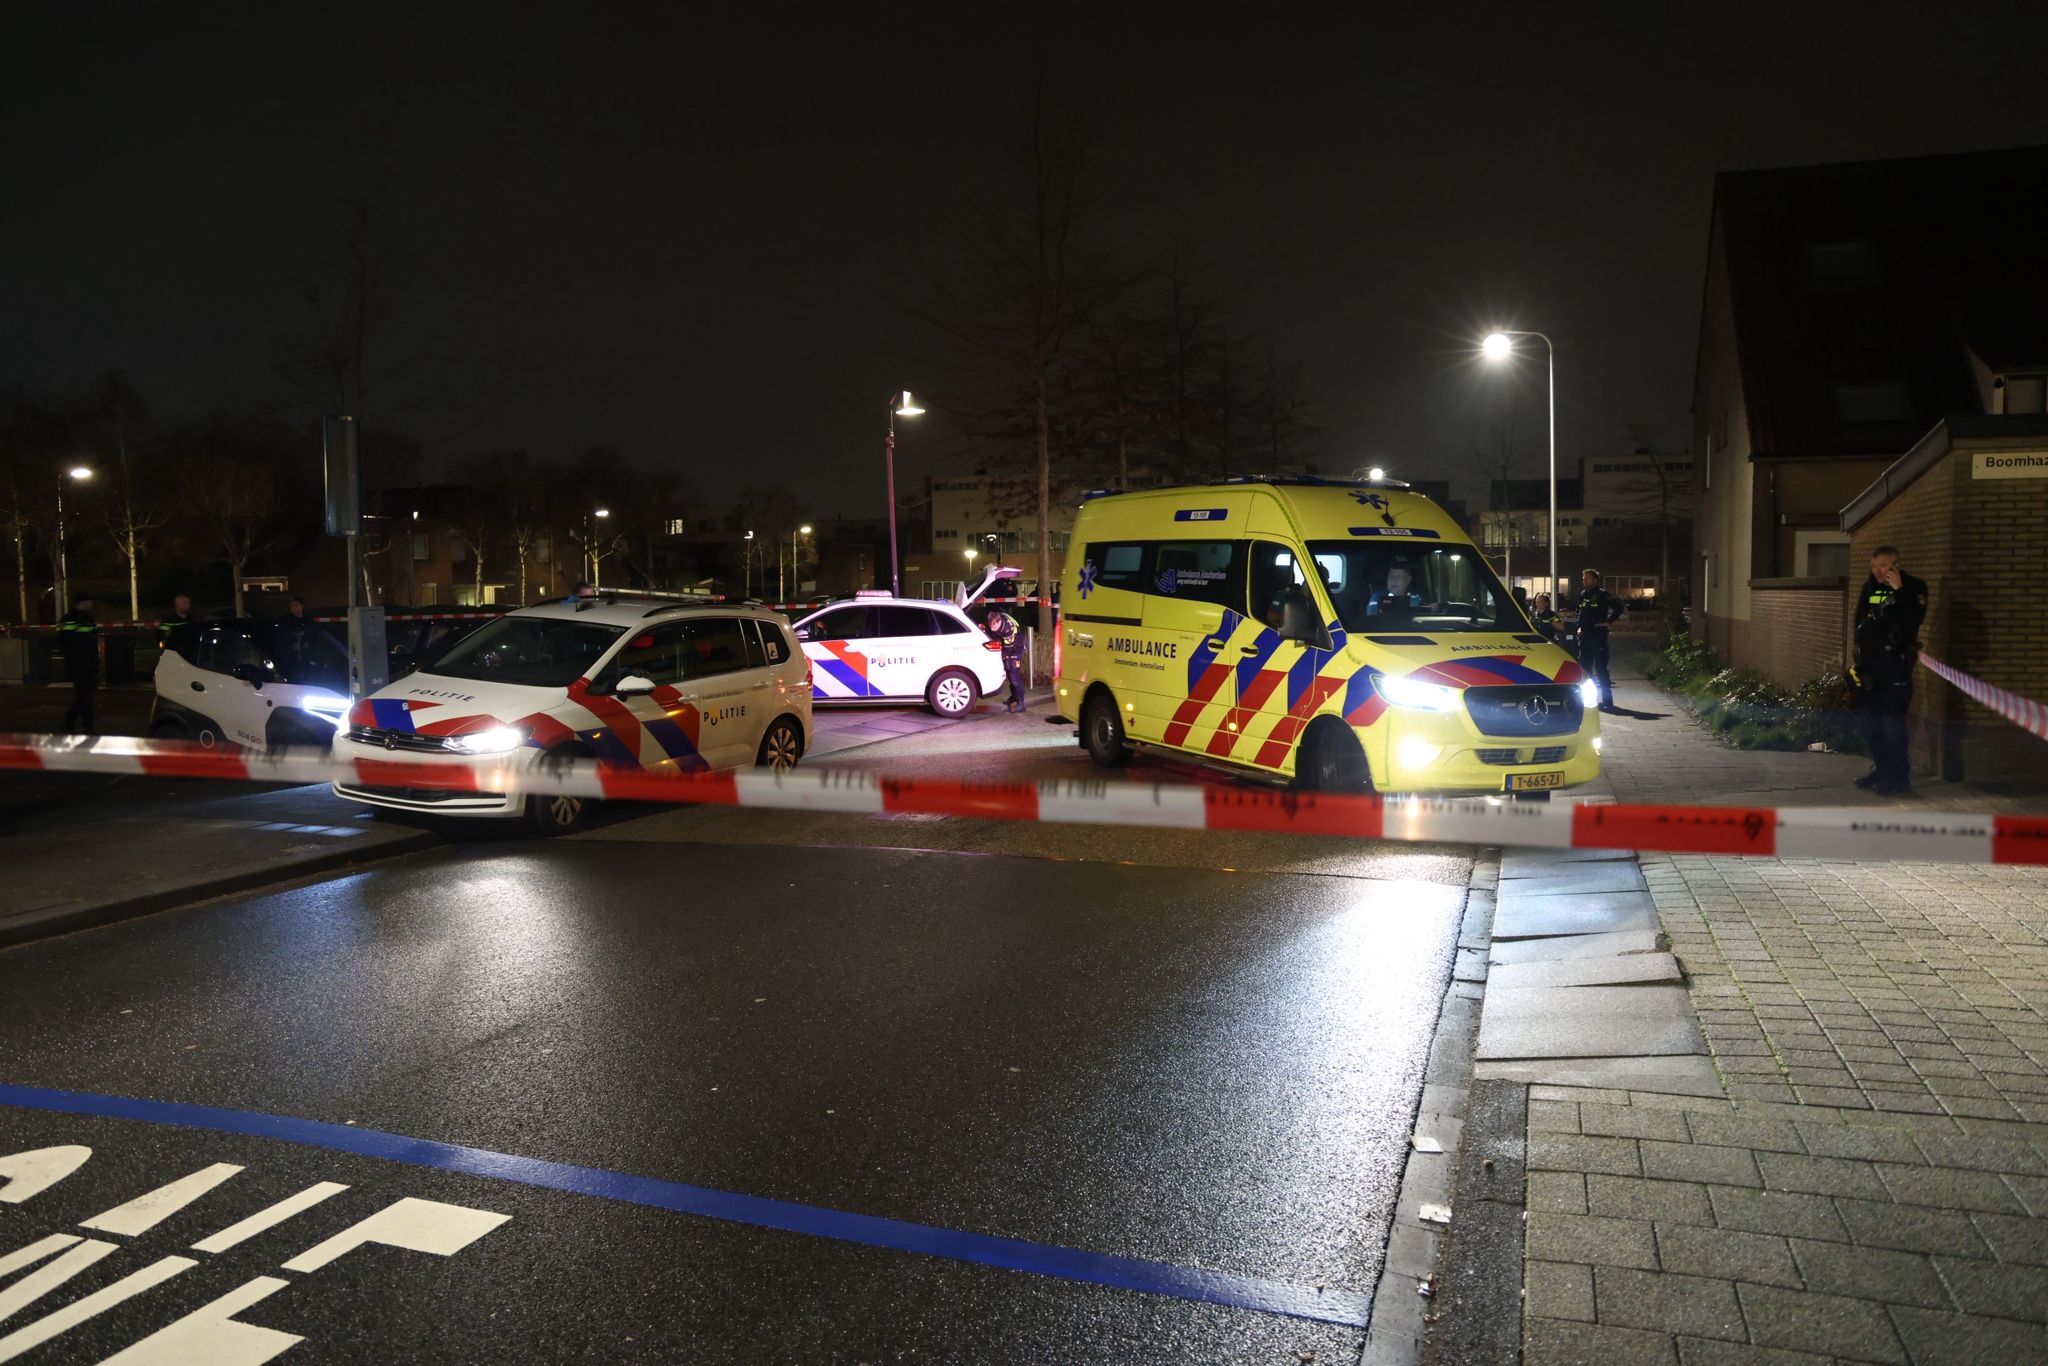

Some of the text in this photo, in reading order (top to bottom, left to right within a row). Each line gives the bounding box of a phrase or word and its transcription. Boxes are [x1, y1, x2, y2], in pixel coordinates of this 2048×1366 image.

[1107, 637, 1177, 659] AMBULANCE
[1451, 644, 1535, 652] AMBULANCE
[871, 656, 917, 668] POLITIE
[408, 688, 476, 702] POLITIE
[704, 705, 746, 726] POLITIE
[1516, 773, 1560, 789] T-665-ZJ
